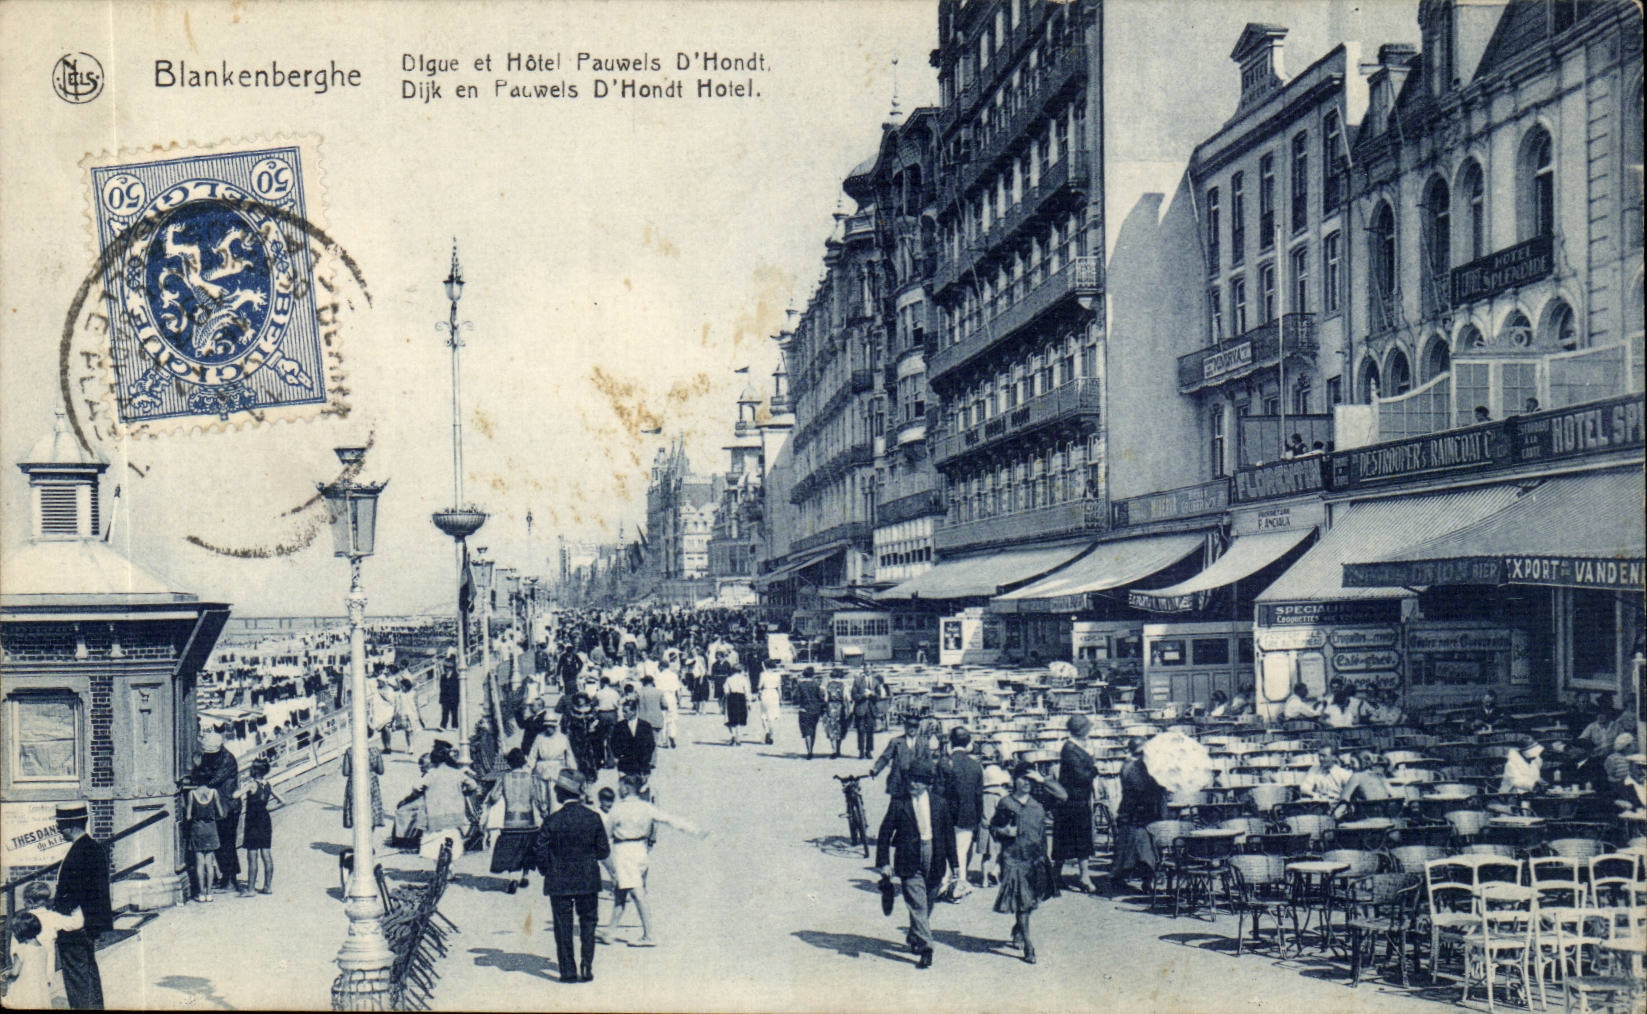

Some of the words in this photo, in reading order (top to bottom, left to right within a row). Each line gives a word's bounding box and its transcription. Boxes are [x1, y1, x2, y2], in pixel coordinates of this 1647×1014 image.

[1430, 431, 1482, 467] RAINCOAT
[1551, 409, 1609, 454] HOTEL
[1506, 558, 1560, 580] EXPORT
